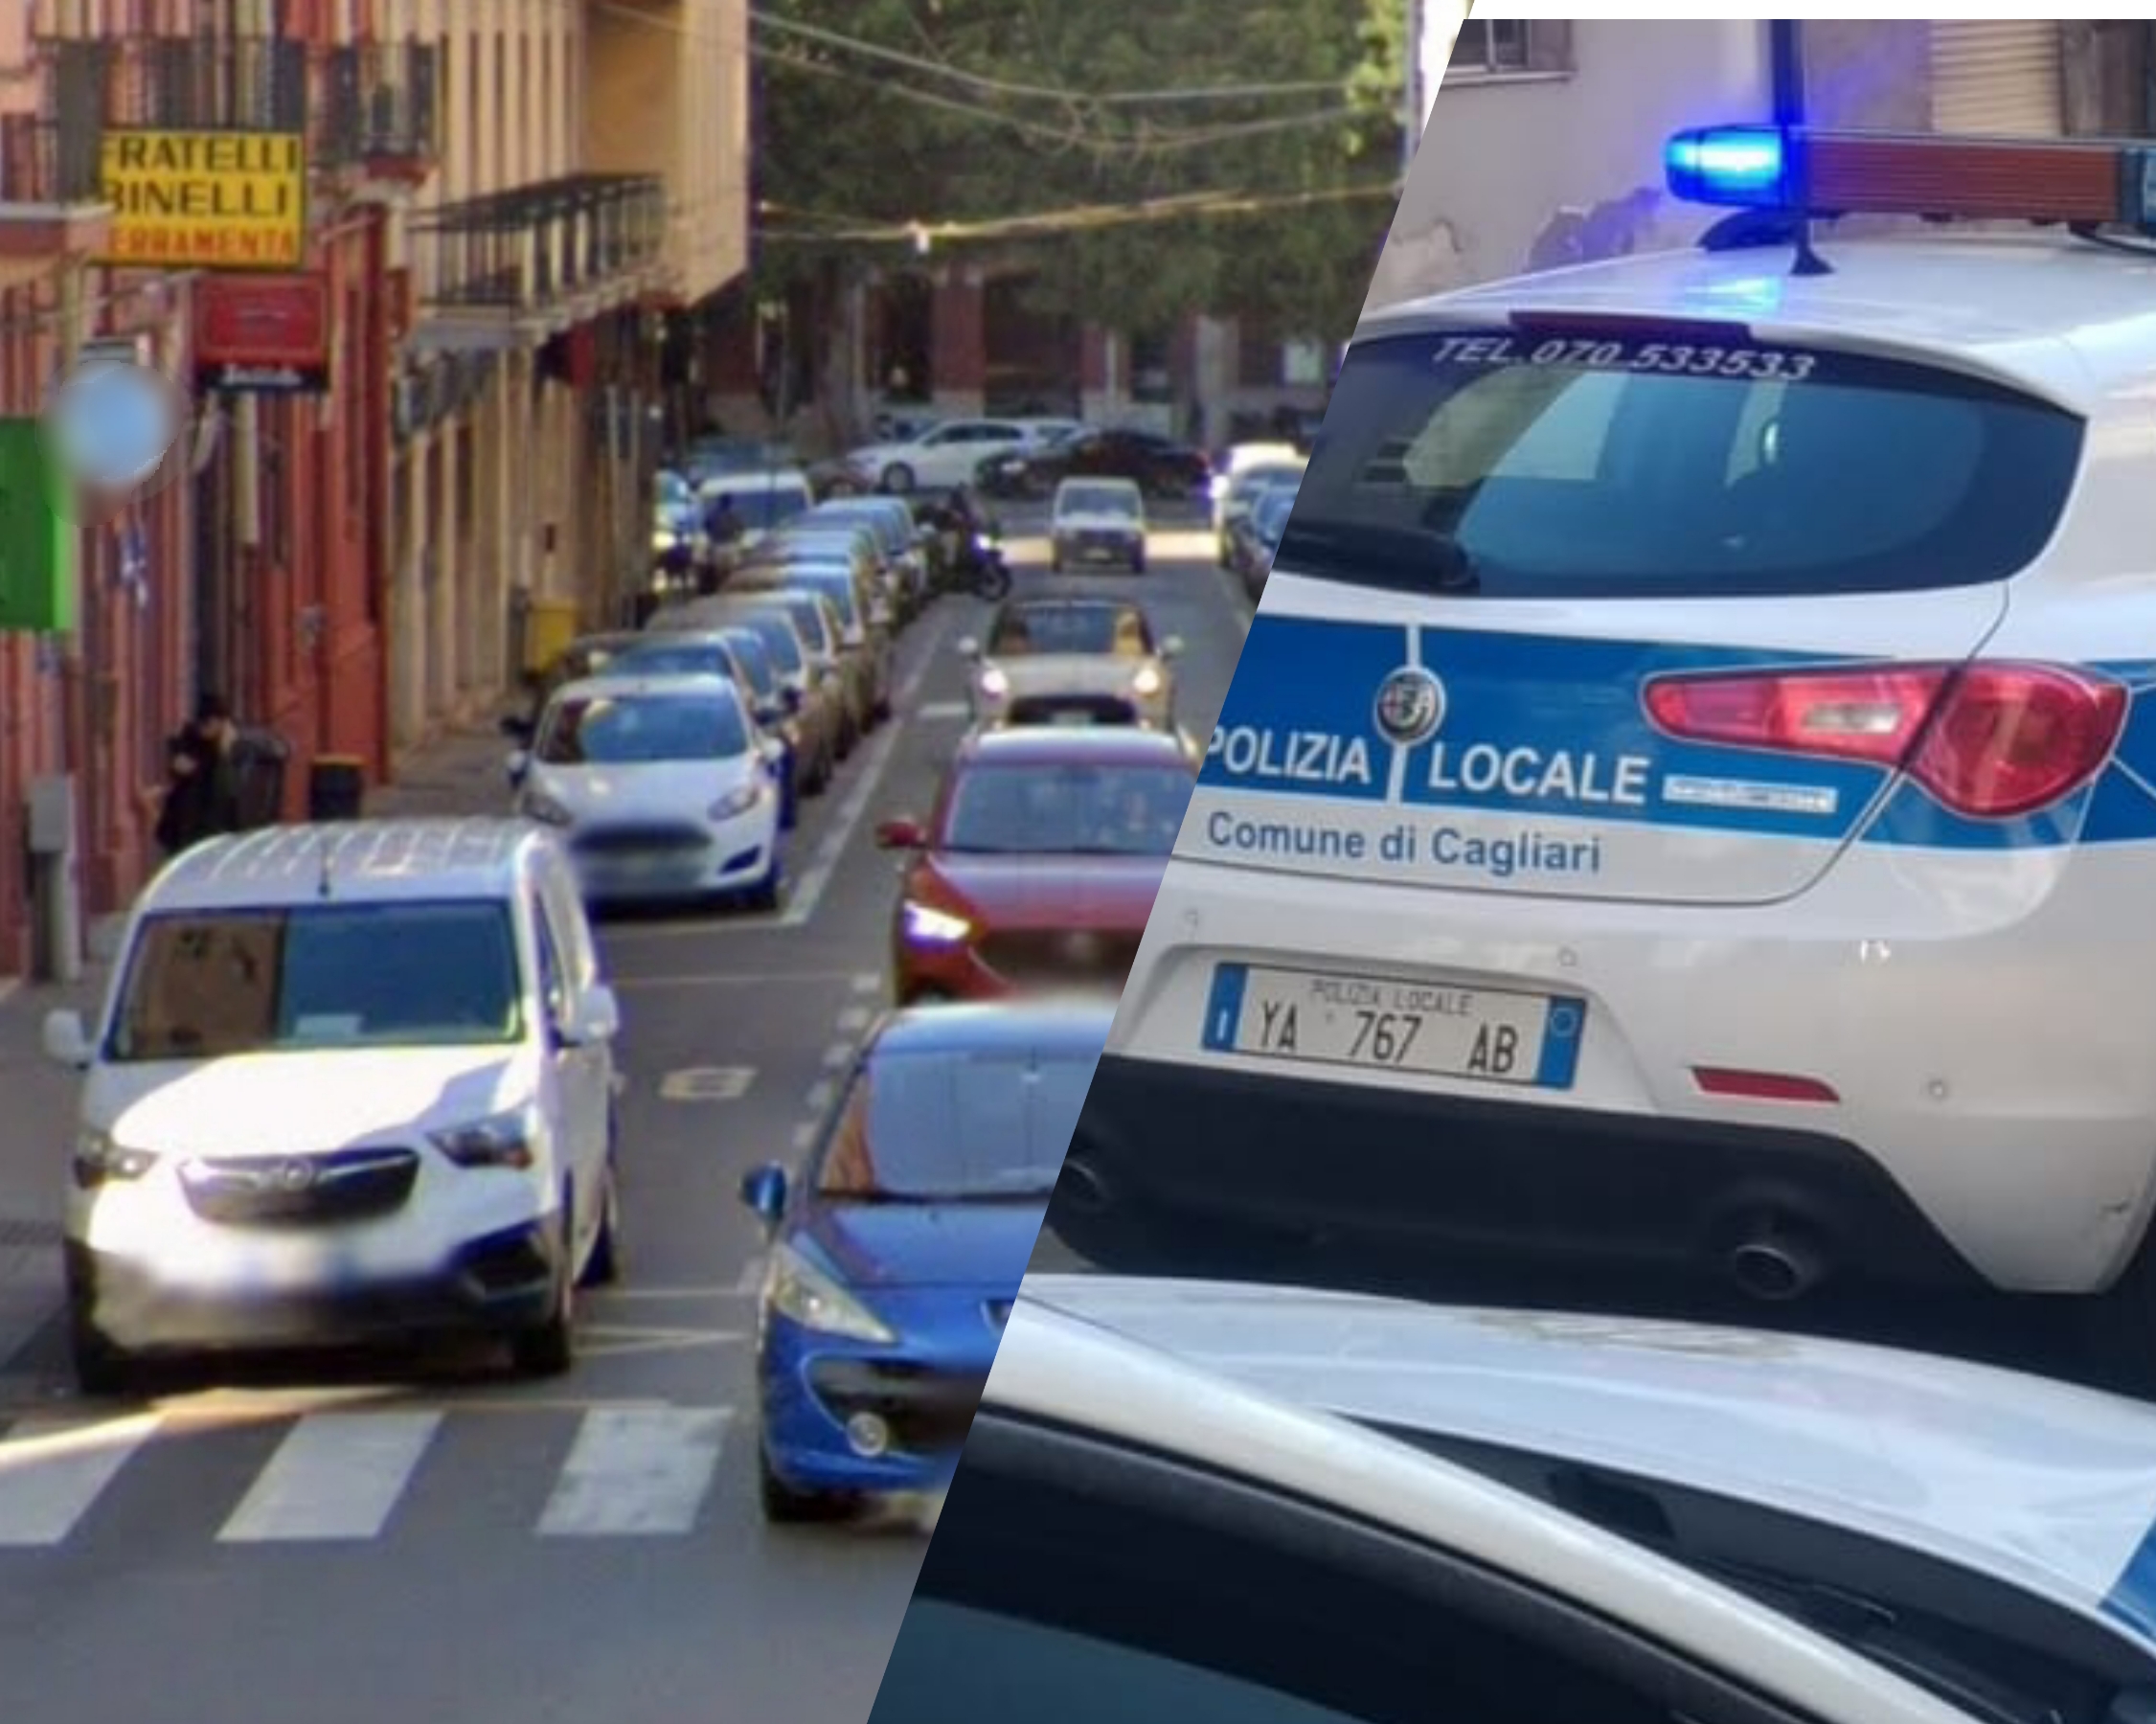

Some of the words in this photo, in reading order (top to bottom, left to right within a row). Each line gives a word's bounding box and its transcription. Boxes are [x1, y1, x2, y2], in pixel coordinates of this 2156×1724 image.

[1629, 343, 1817, 380] 533533
[1428, 740, 1651, 805] LOCALE
[1209, 810, 1366, 858] Comune
[1379, 825, 1417, 863] di
[1431, 827, 1600, 877] Cagliari
[1311, 978, 1379, 1006] POLIZIA
[1393, 990, 1474, 1016] LOCALE
[1260, 1000, 1299, 1050] YA
[1349, 1009, 1423, 1063] 767
[1466, 1020, 1519, 1074] AB
